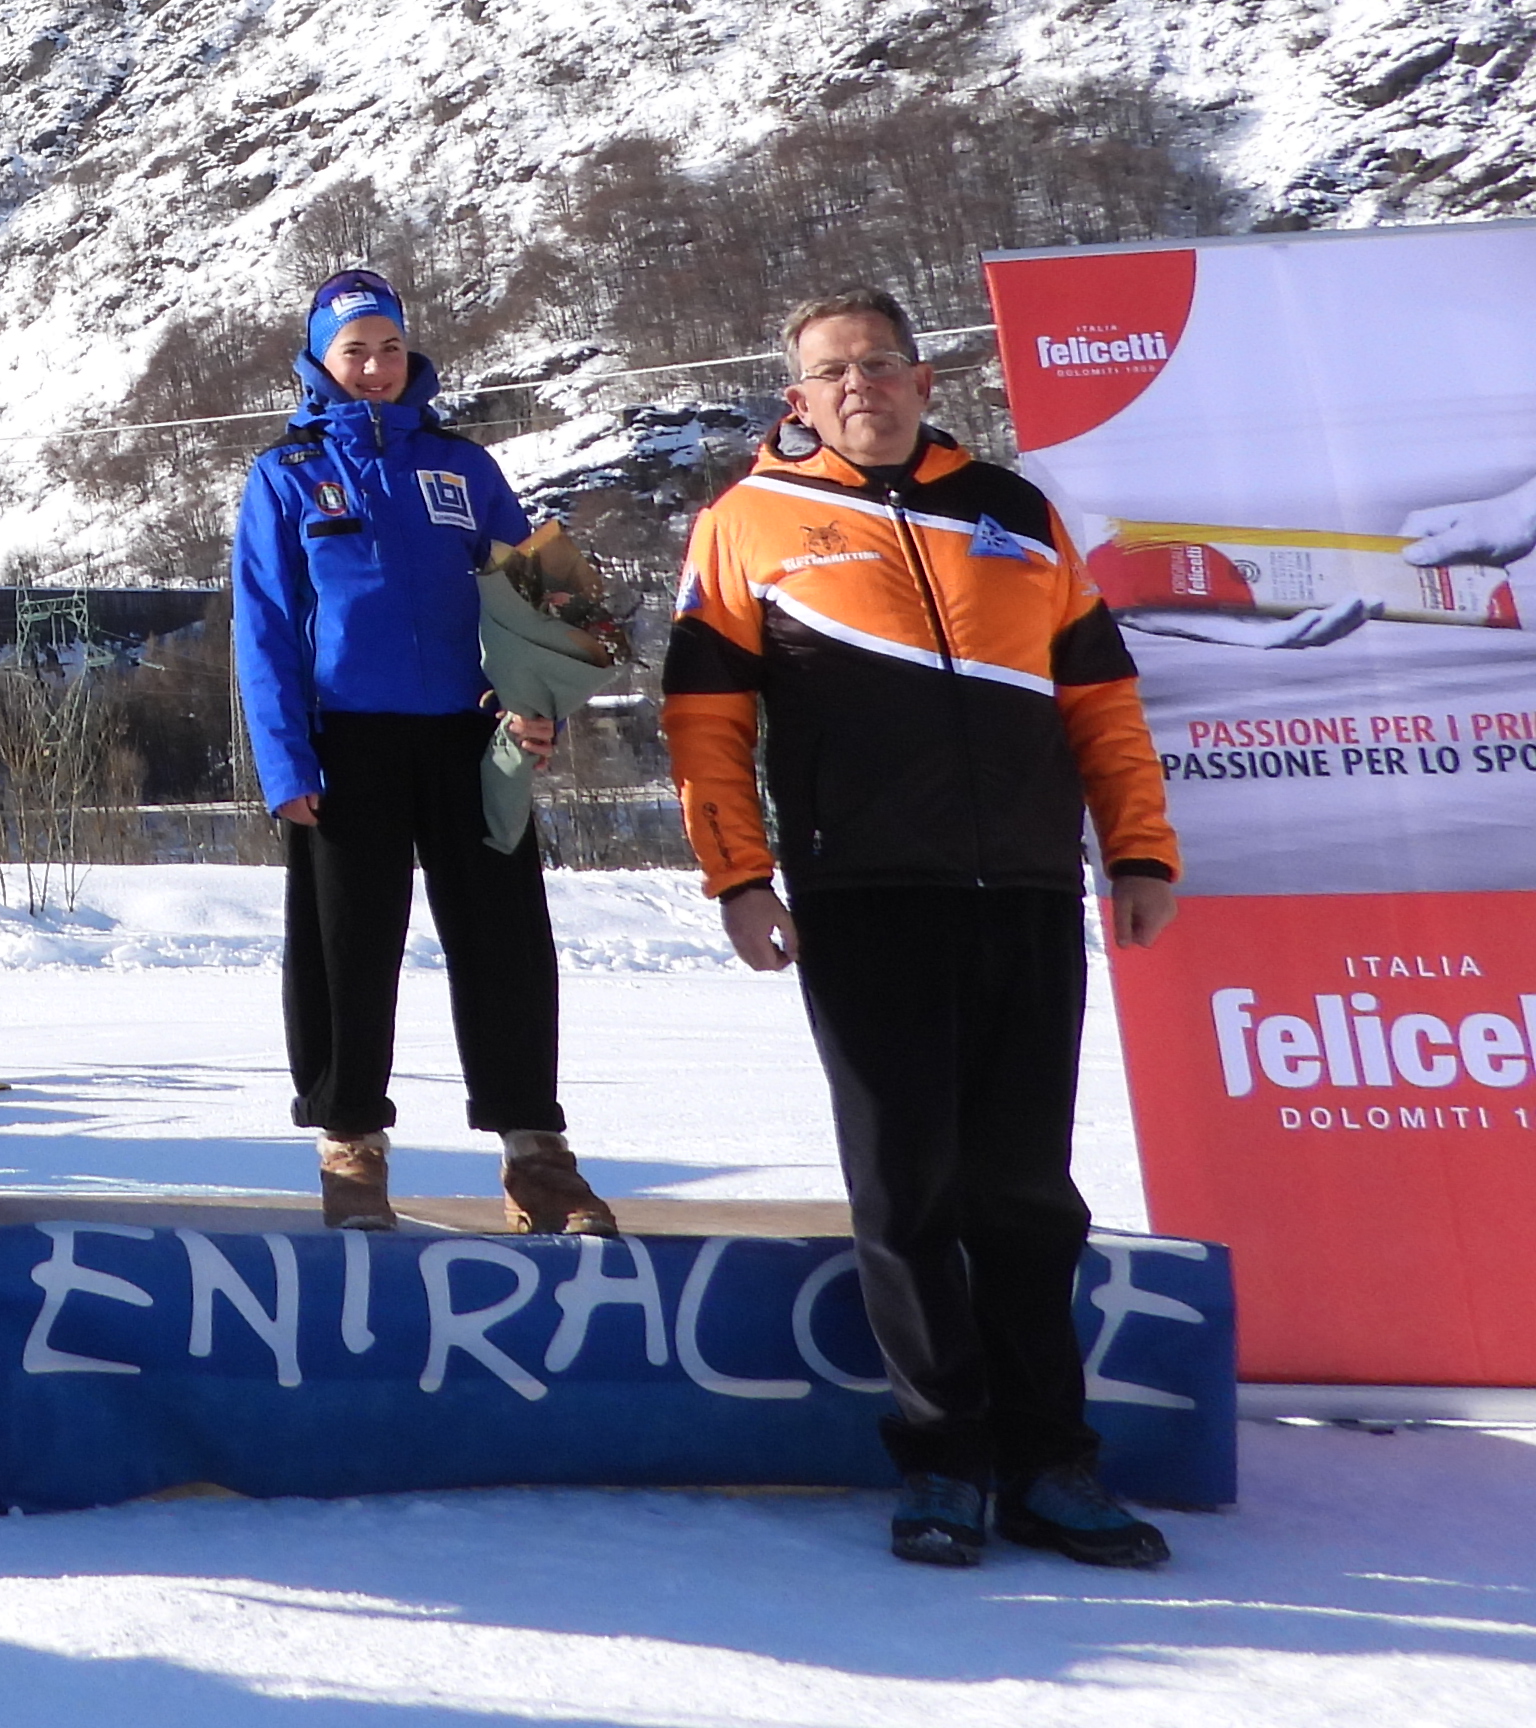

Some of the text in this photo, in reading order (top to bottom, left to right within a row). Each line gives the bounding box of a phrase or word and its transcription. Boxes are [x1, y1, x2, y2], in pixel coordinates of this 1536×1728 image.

[1036, 331, 1168, 369] felicetti
[1188, 711, 1536, 749] PASSIONE PER I PRI
[1161, 748, 1331, 781] PASSIONE
[1341, 746, 1408, 777] PER
[1417, 745, 1461, 775] LO
[1344, 955, 1482, 978] ITALIA
[1280, 1105, 1490, 1130] DOLOMITI
